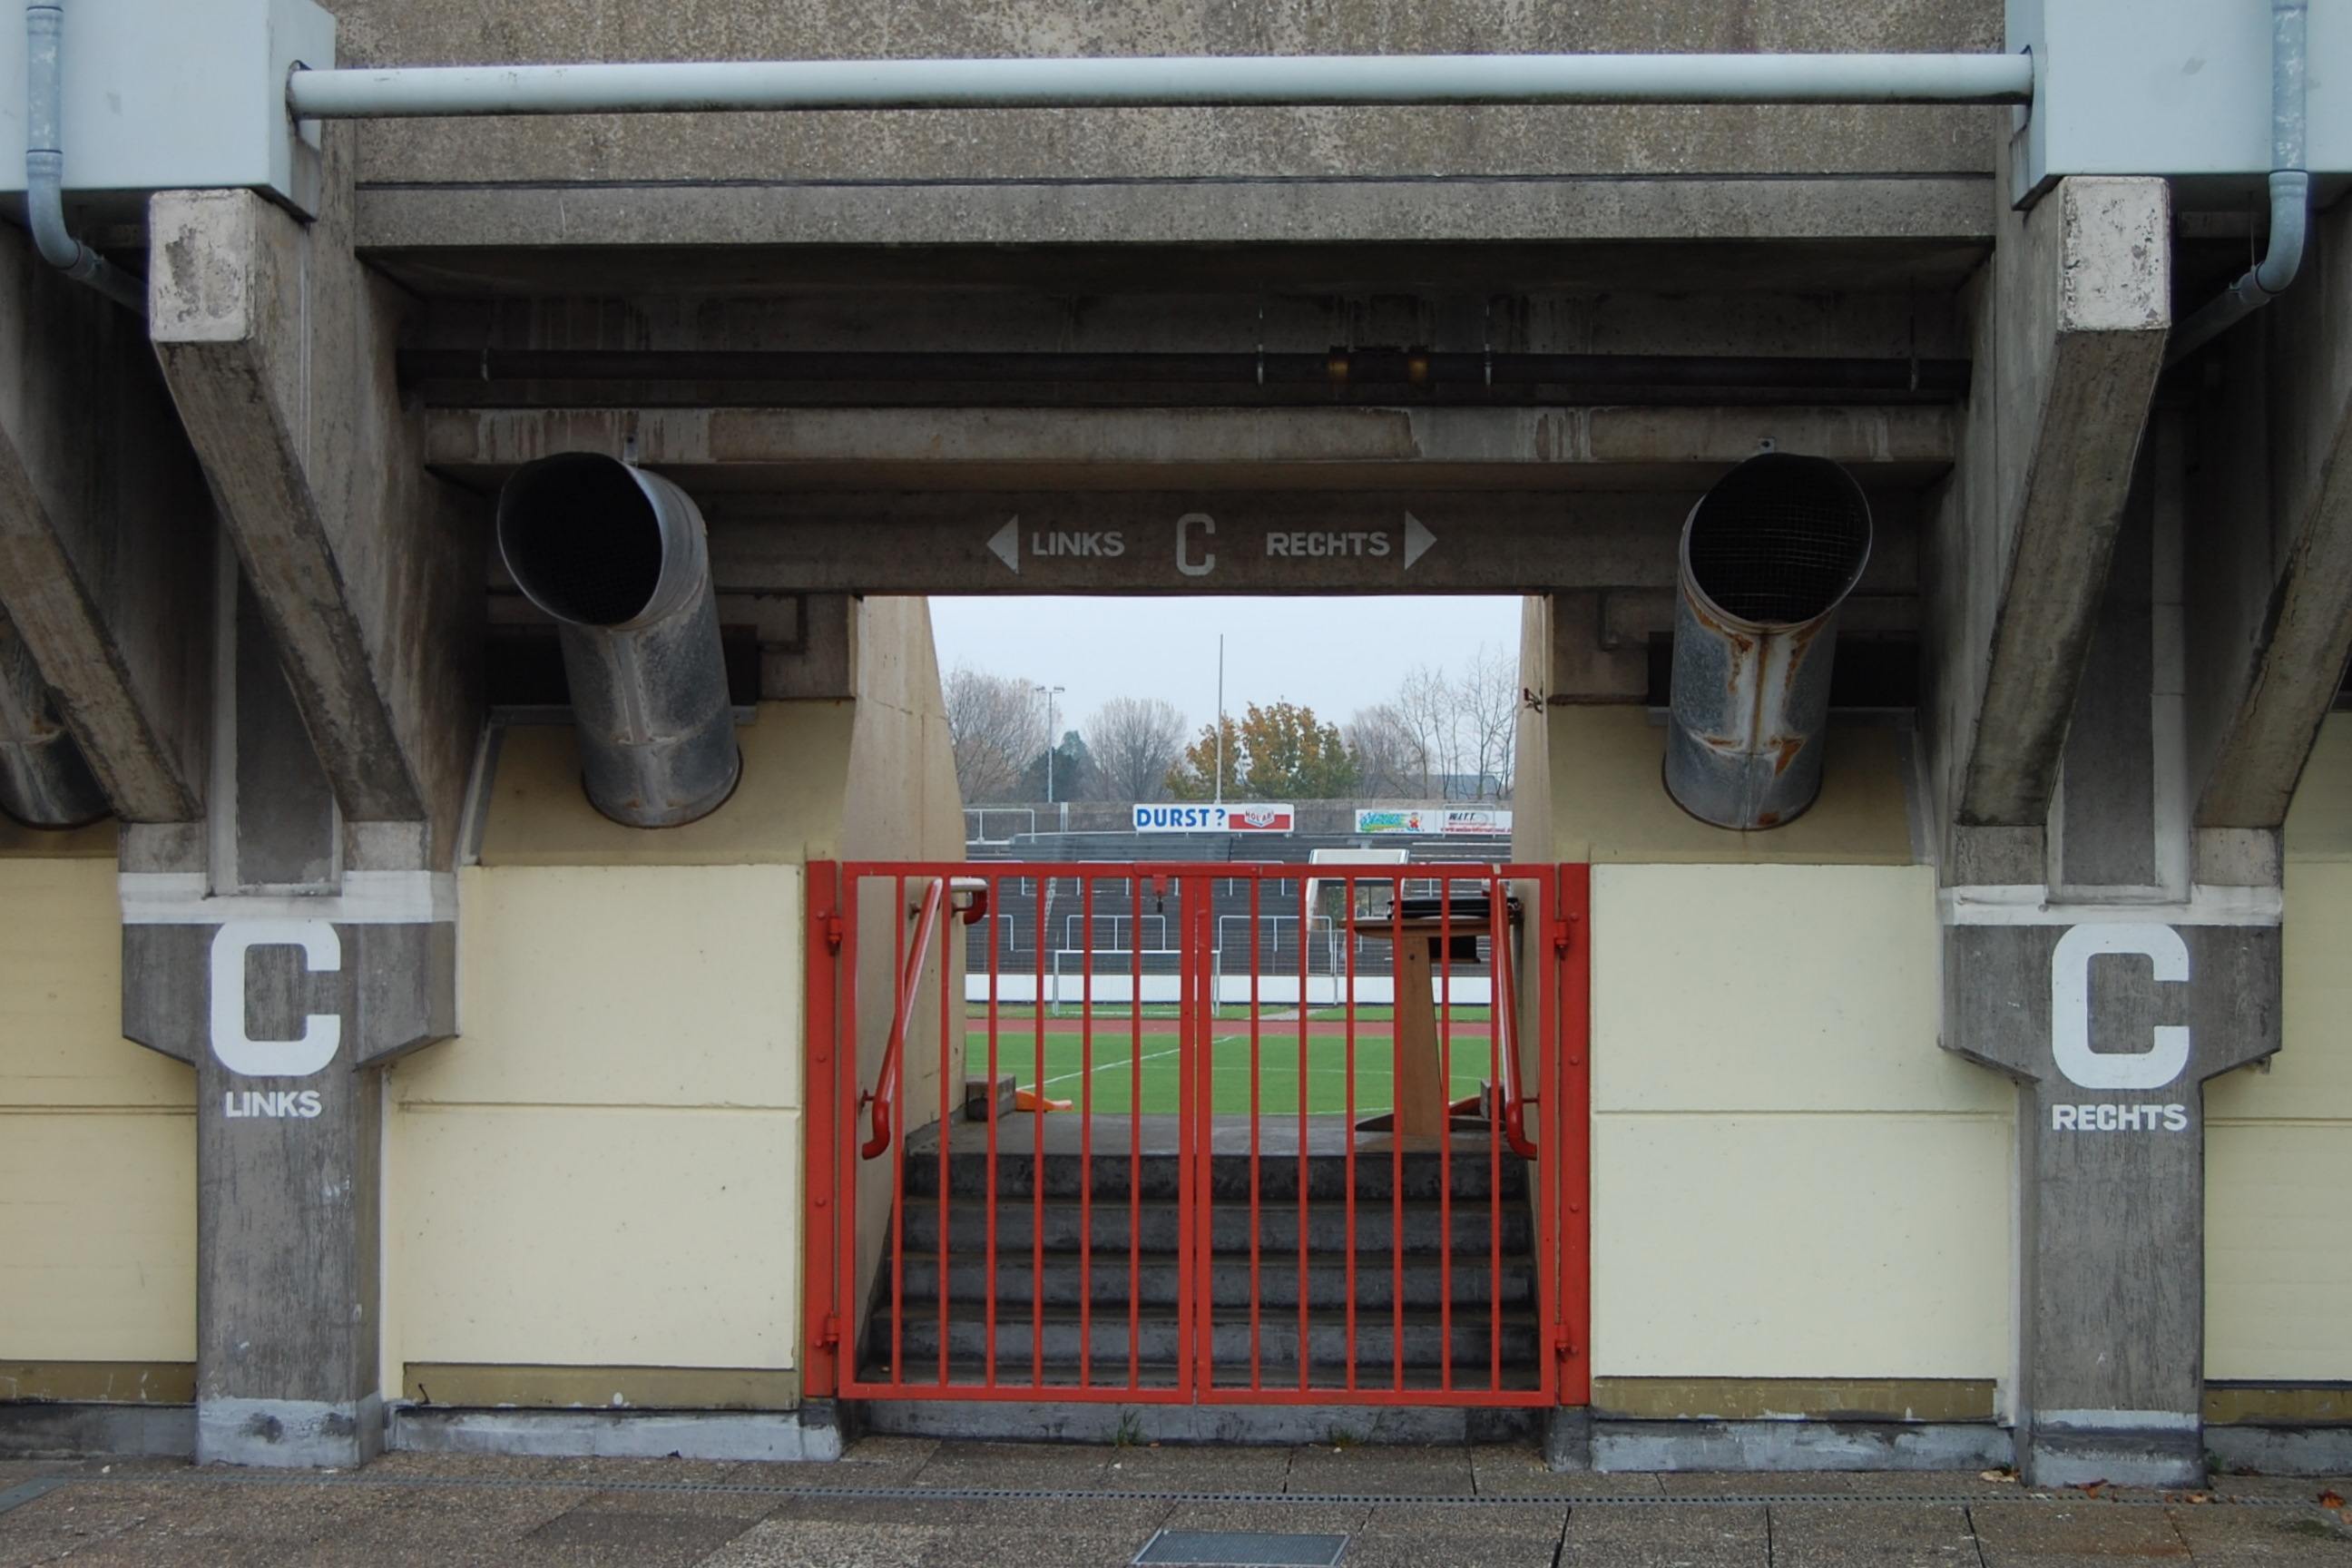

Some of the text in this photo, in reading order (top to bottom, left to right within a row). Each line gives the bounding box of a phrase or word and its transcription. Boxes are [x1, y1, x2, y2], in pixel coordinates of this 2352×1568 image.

[1033, 513, 1390, 576] LINKS C RECHTS
[211, 920, 341, 1076] C
[2052, 923, 2190, 1089] C
[225, 1091, 322, 1118] LINKS
[2052, 1103, 2188, 1132] RECHTS
